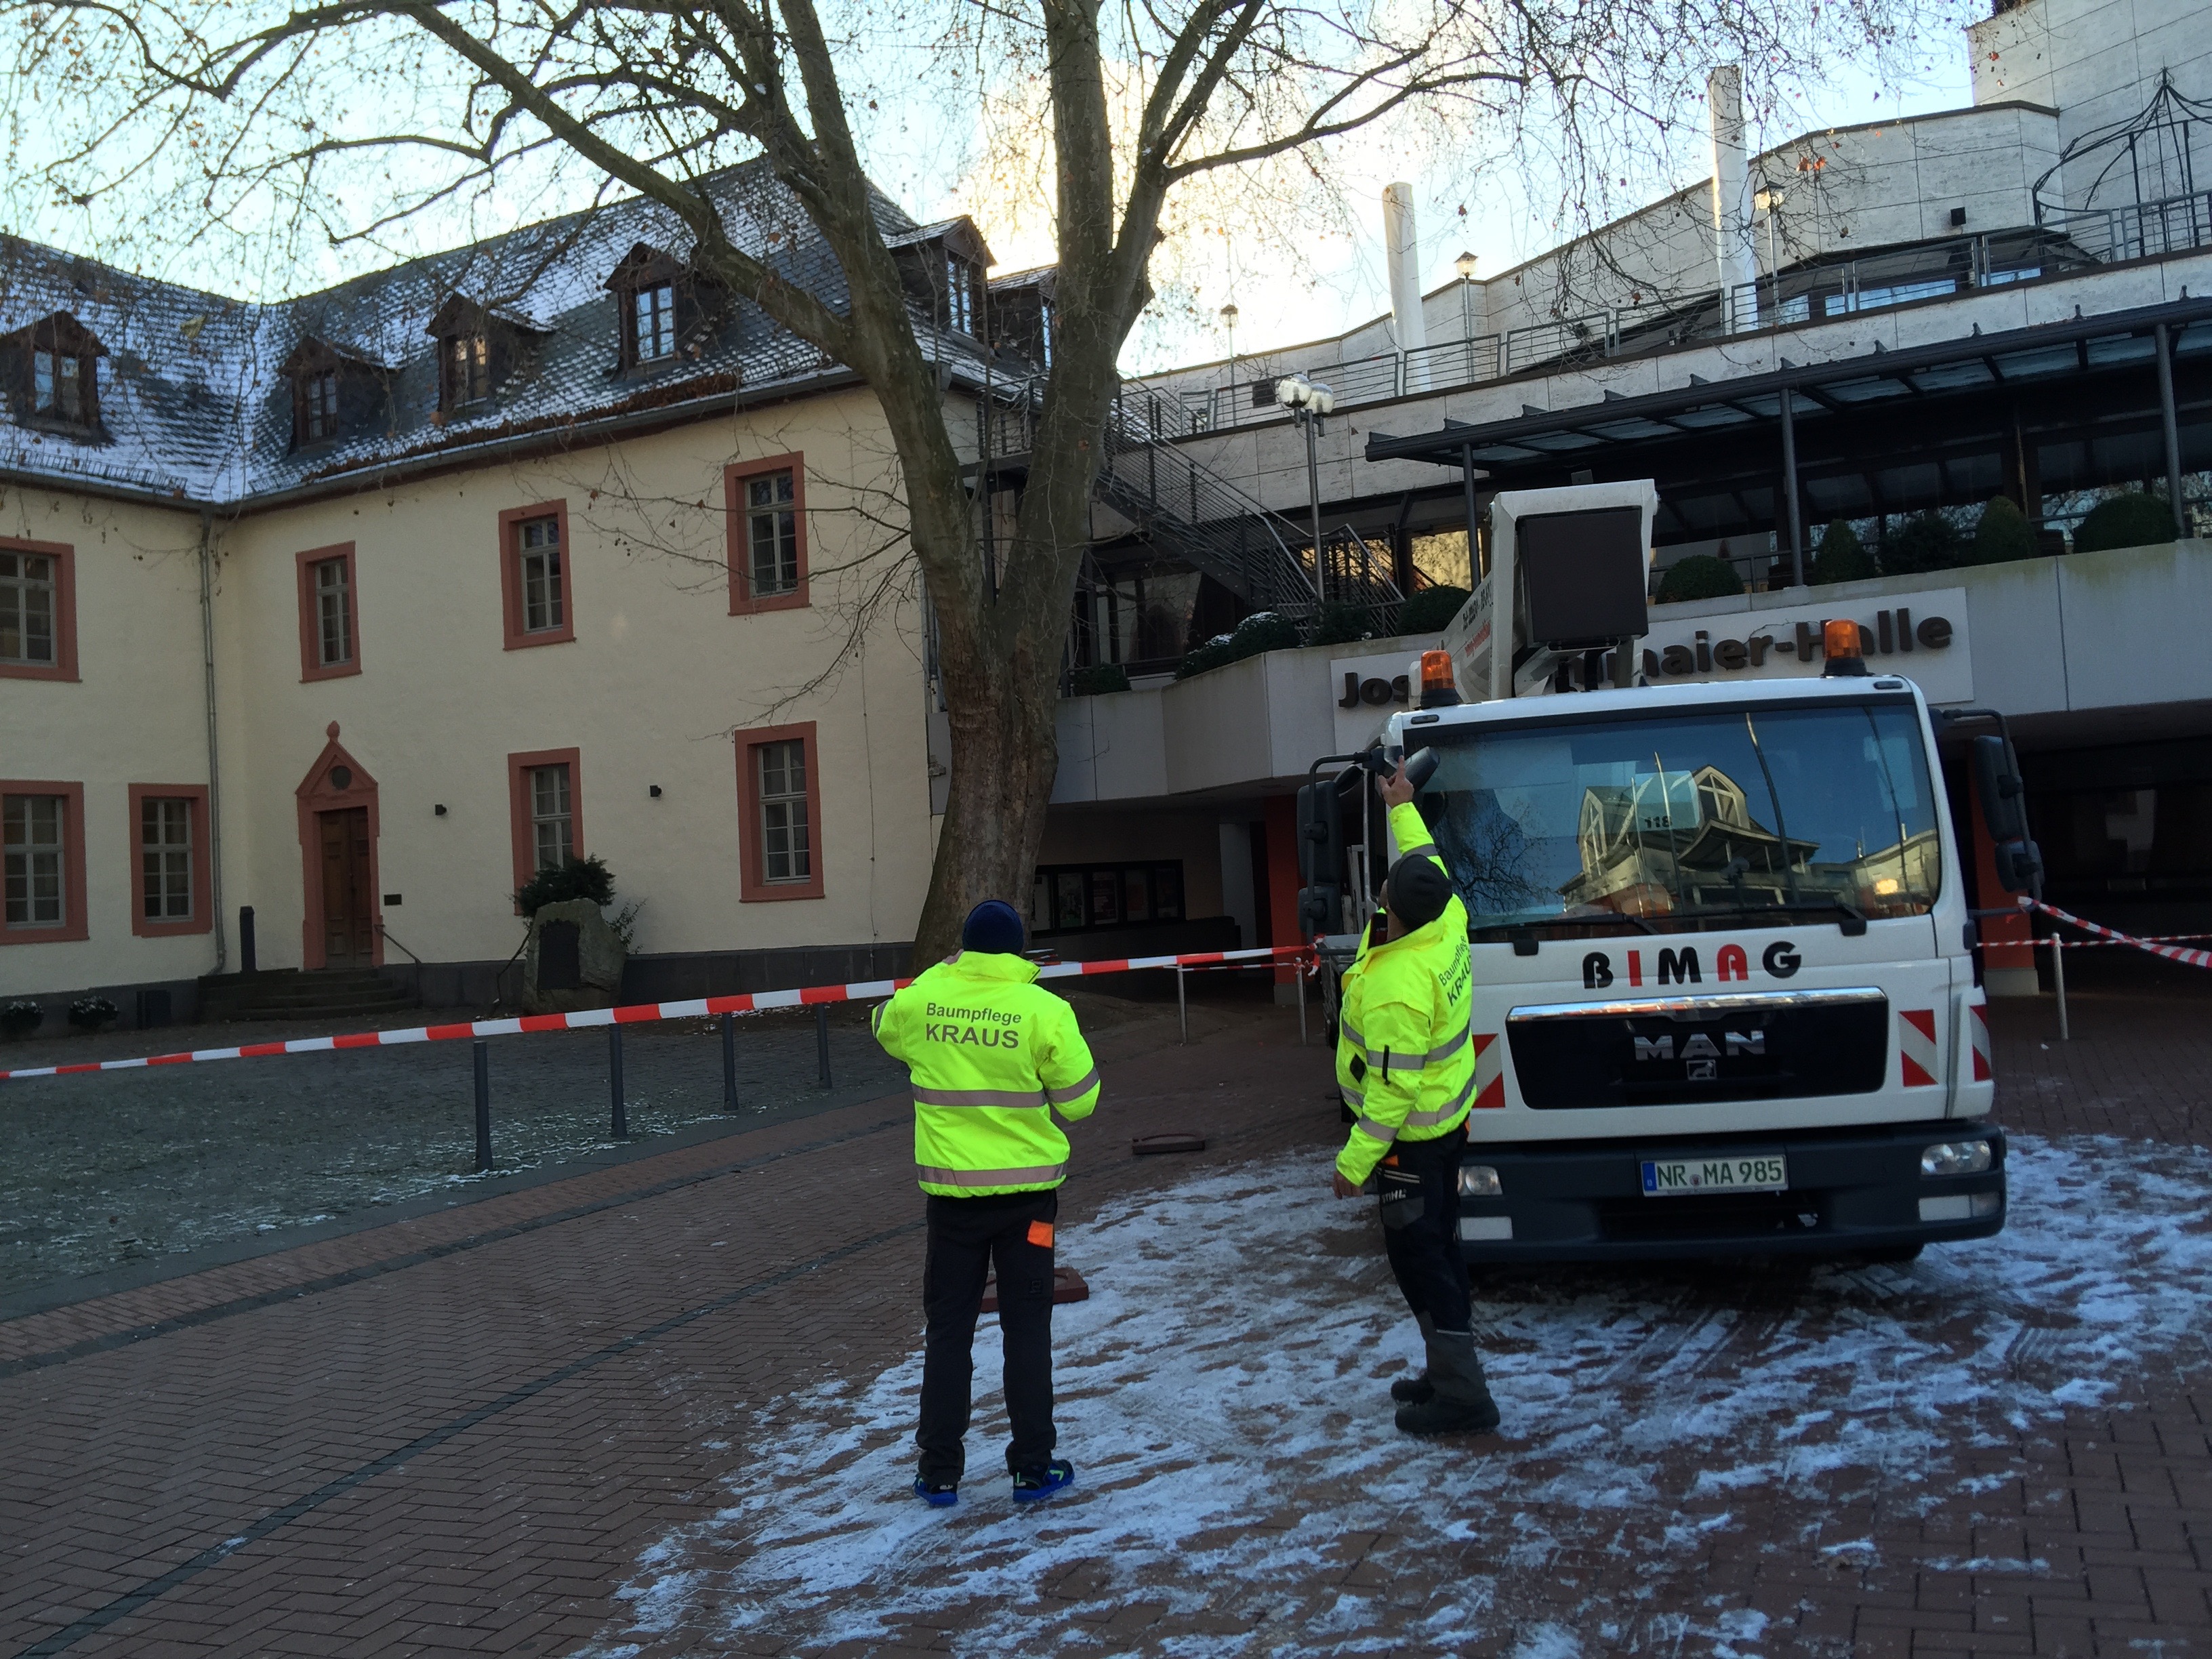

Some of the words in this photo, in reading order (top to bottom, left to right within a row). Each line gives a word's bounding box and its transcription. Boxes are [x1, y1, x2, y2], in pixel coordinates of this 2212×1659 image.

[1582, 941, 1802, 989] BIMAG
[1446, 954, 1471, 1007] KRAU
[926, 1002, 1022, 1027] Baumpflege
[925, 1023, 1019, 1049] KRAUS
[1634, 1029, 1766, 1061] MAN
[1656, 1164, 1688, 1187] NR
[1702, 1162, 1734, 1185] MA
[1738, 1160, 1783, 1183] 985
